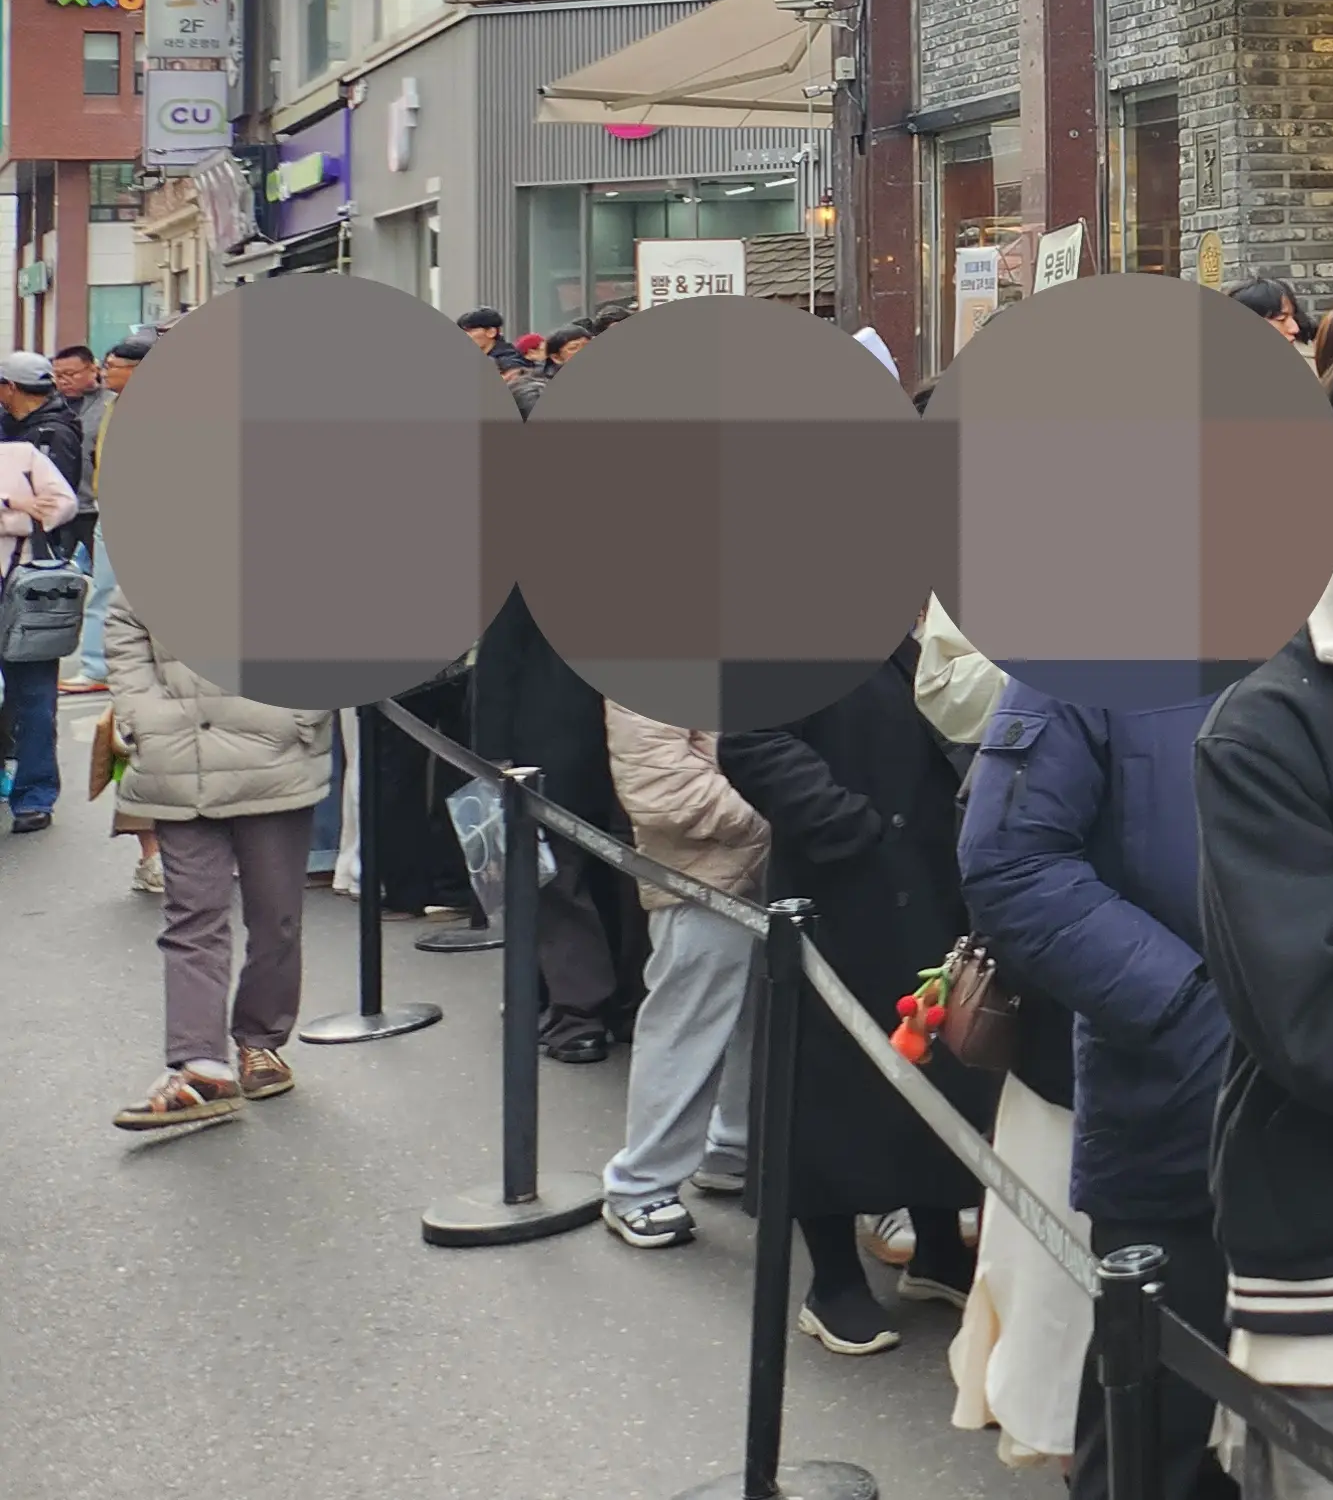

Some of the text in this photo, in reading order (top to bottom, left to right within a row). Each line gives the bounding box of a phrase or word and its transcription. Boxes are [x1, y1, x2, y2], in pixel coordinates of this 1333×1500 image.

[179, 18, 205, 34] 2F
[170, 106, 212, 124] CU
[650, 273, 734, 297] 빵 & 커피
